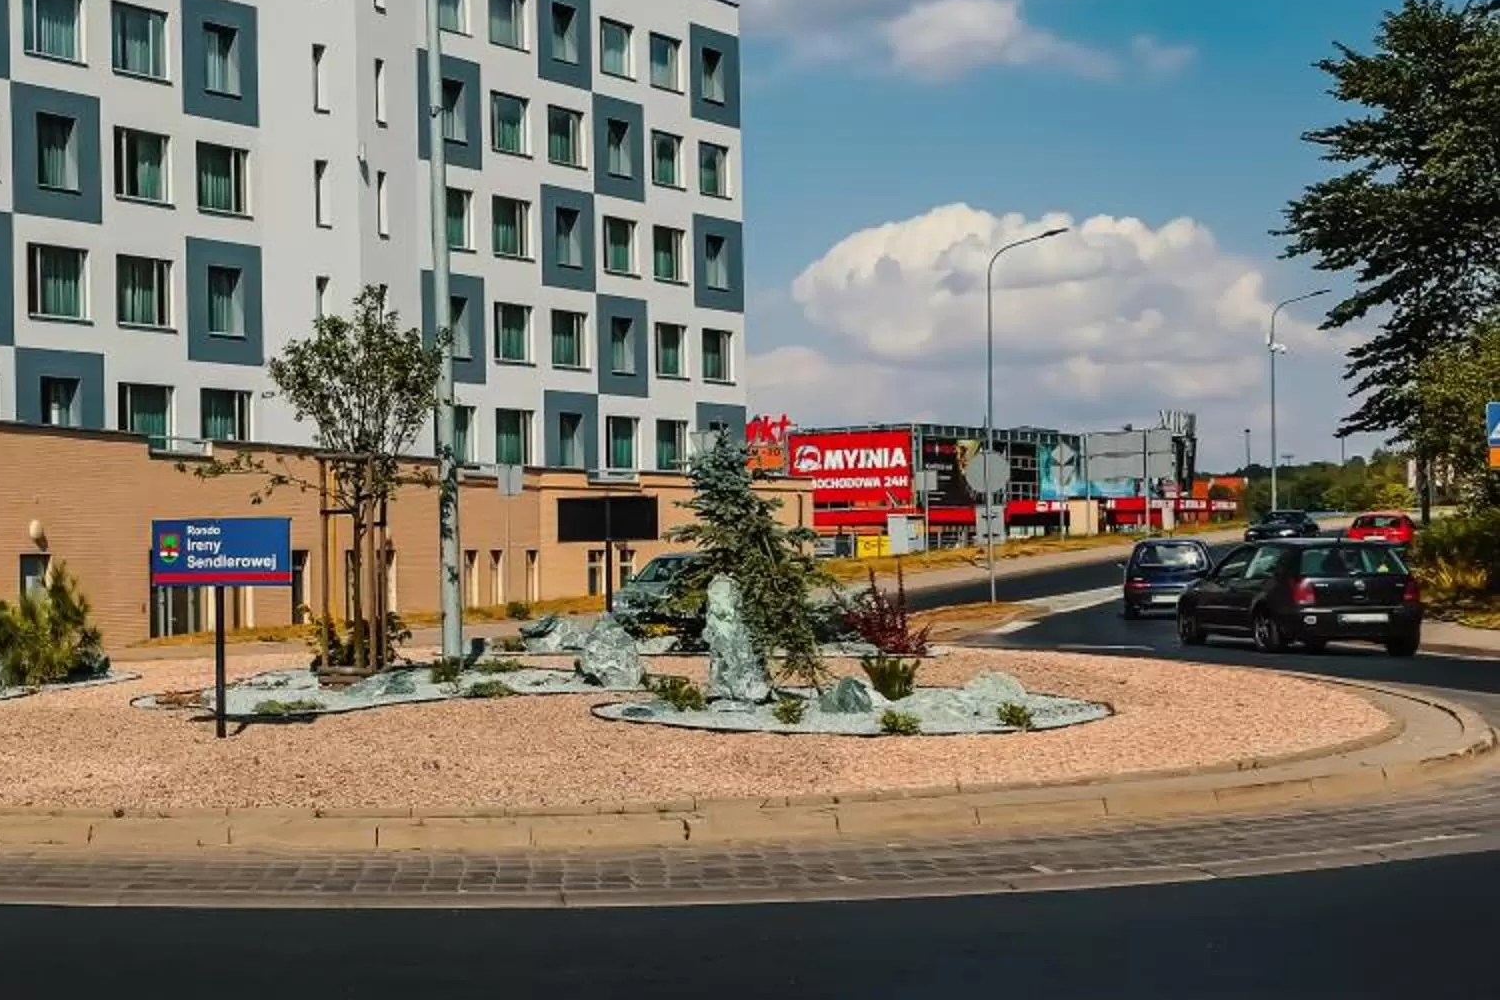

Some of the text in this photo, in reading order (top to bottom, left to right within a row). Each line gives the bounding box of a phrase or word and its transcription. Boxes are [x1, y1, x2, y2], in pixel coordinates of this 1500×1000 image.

[823, 447, 907, 470] MYJNIA
[812, 476, 909, 489] OCHODOWA 24H
[187, 525, 221, 535] Rondo
[187, 539, 222, 554] Ireny
[187, 554, 277, 571] Sendlerowej
